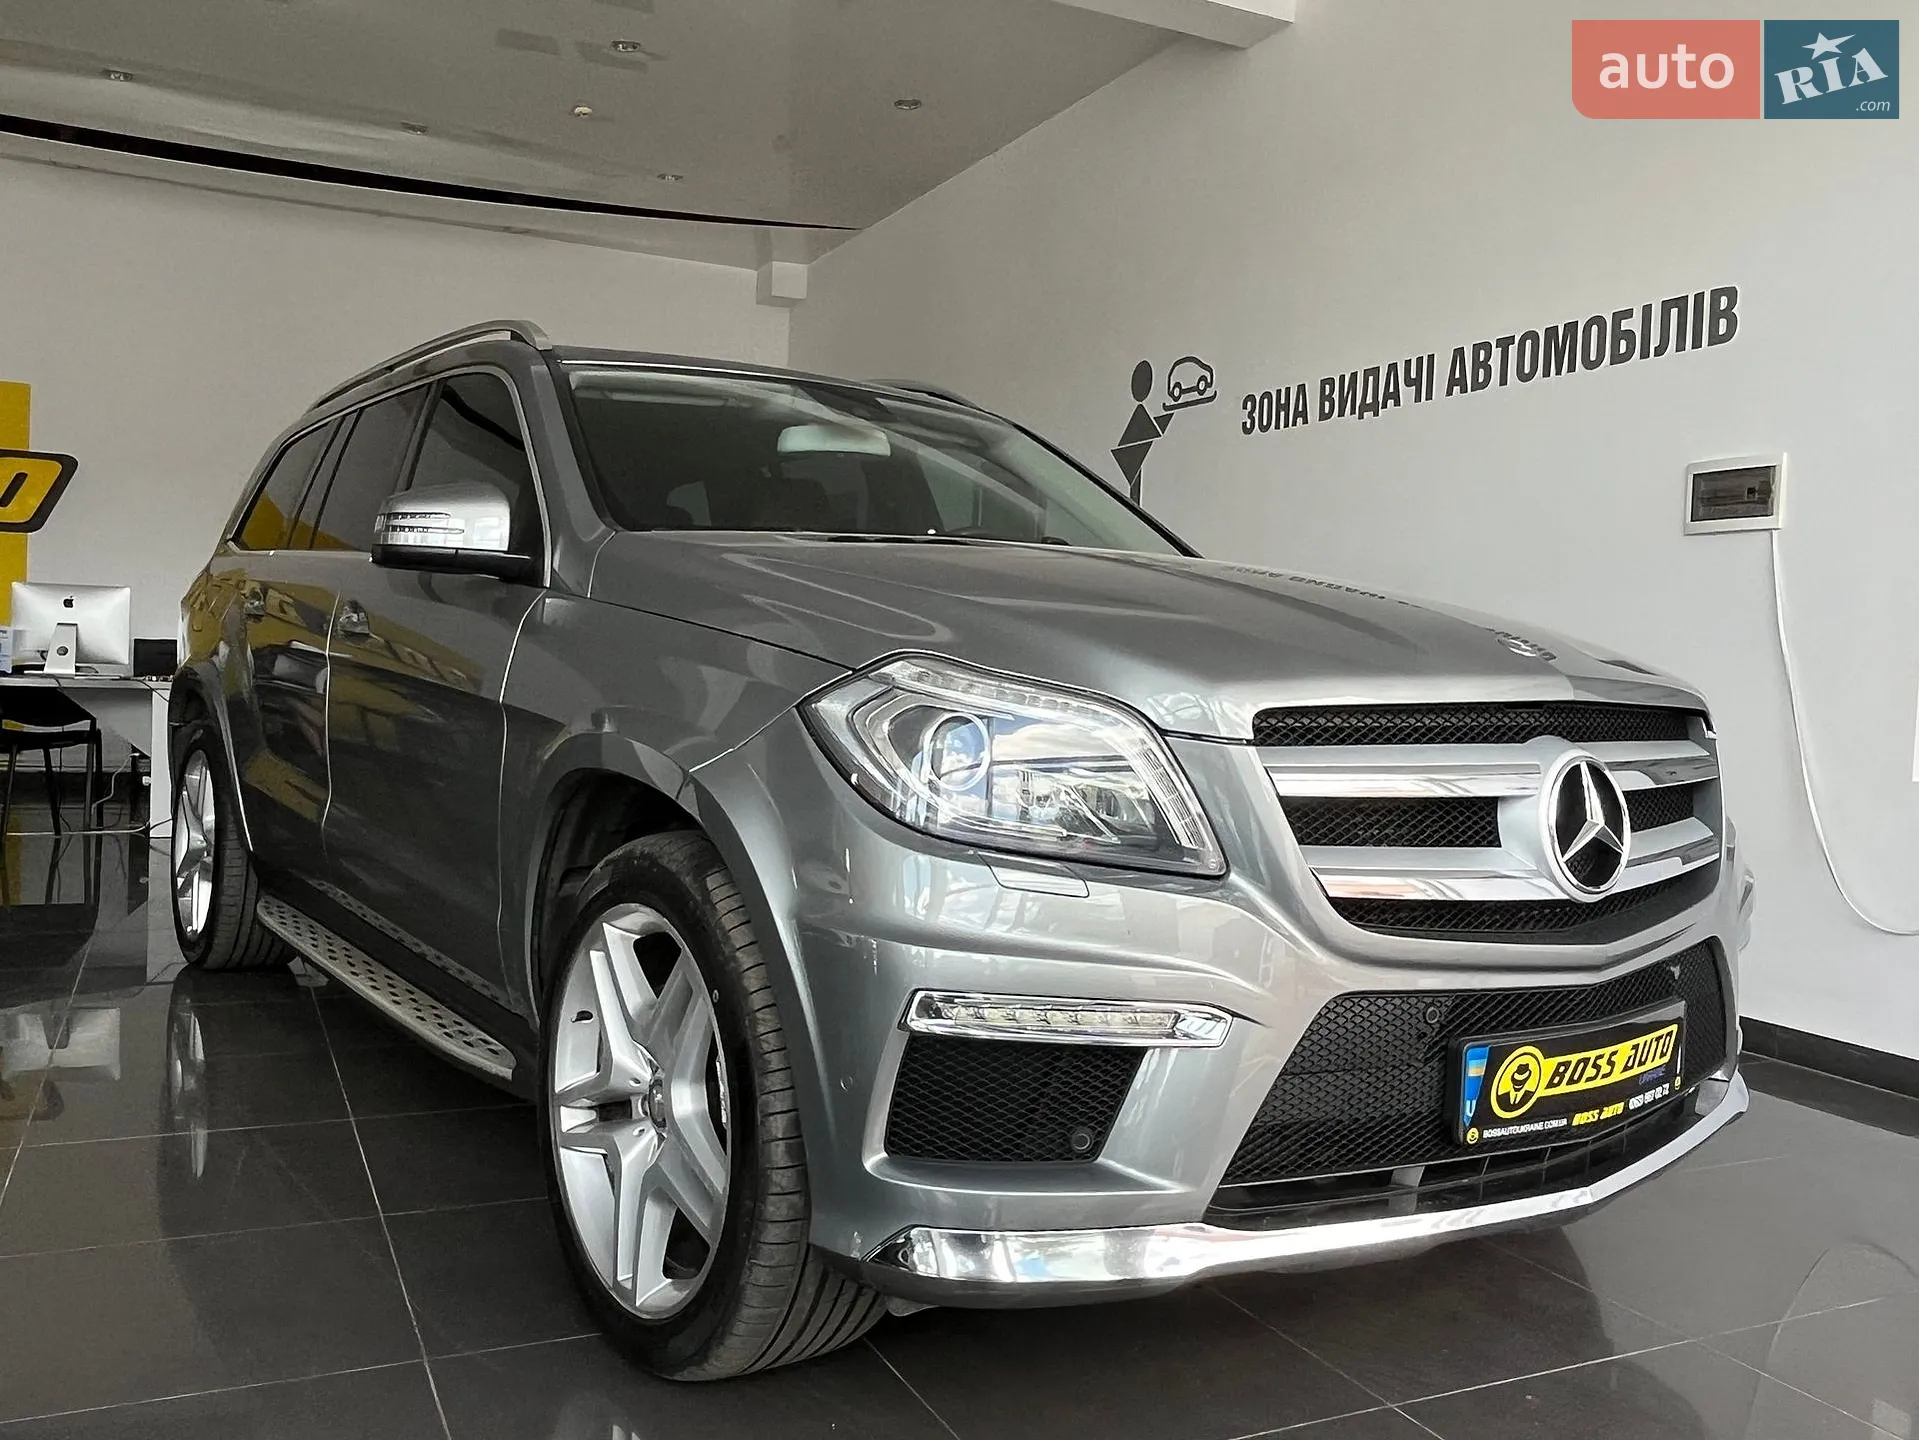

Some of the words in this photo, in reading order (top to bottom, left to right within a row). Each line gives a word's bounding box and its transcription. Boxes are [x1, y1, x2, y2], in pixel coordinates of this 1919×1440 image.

[1241, 382, 1309, 436] ЗОНА
[1318, 353, 1436, 423] ВИДАЧІ
[1445, 285, 1740, 398] АВТОМОБІЛІВ
[1544, 1050, 1621, 1090] BOSS
[1620, 1031, 1675, 1074] AUTO
[1572, 1109, 1600, 1126] BOSS
